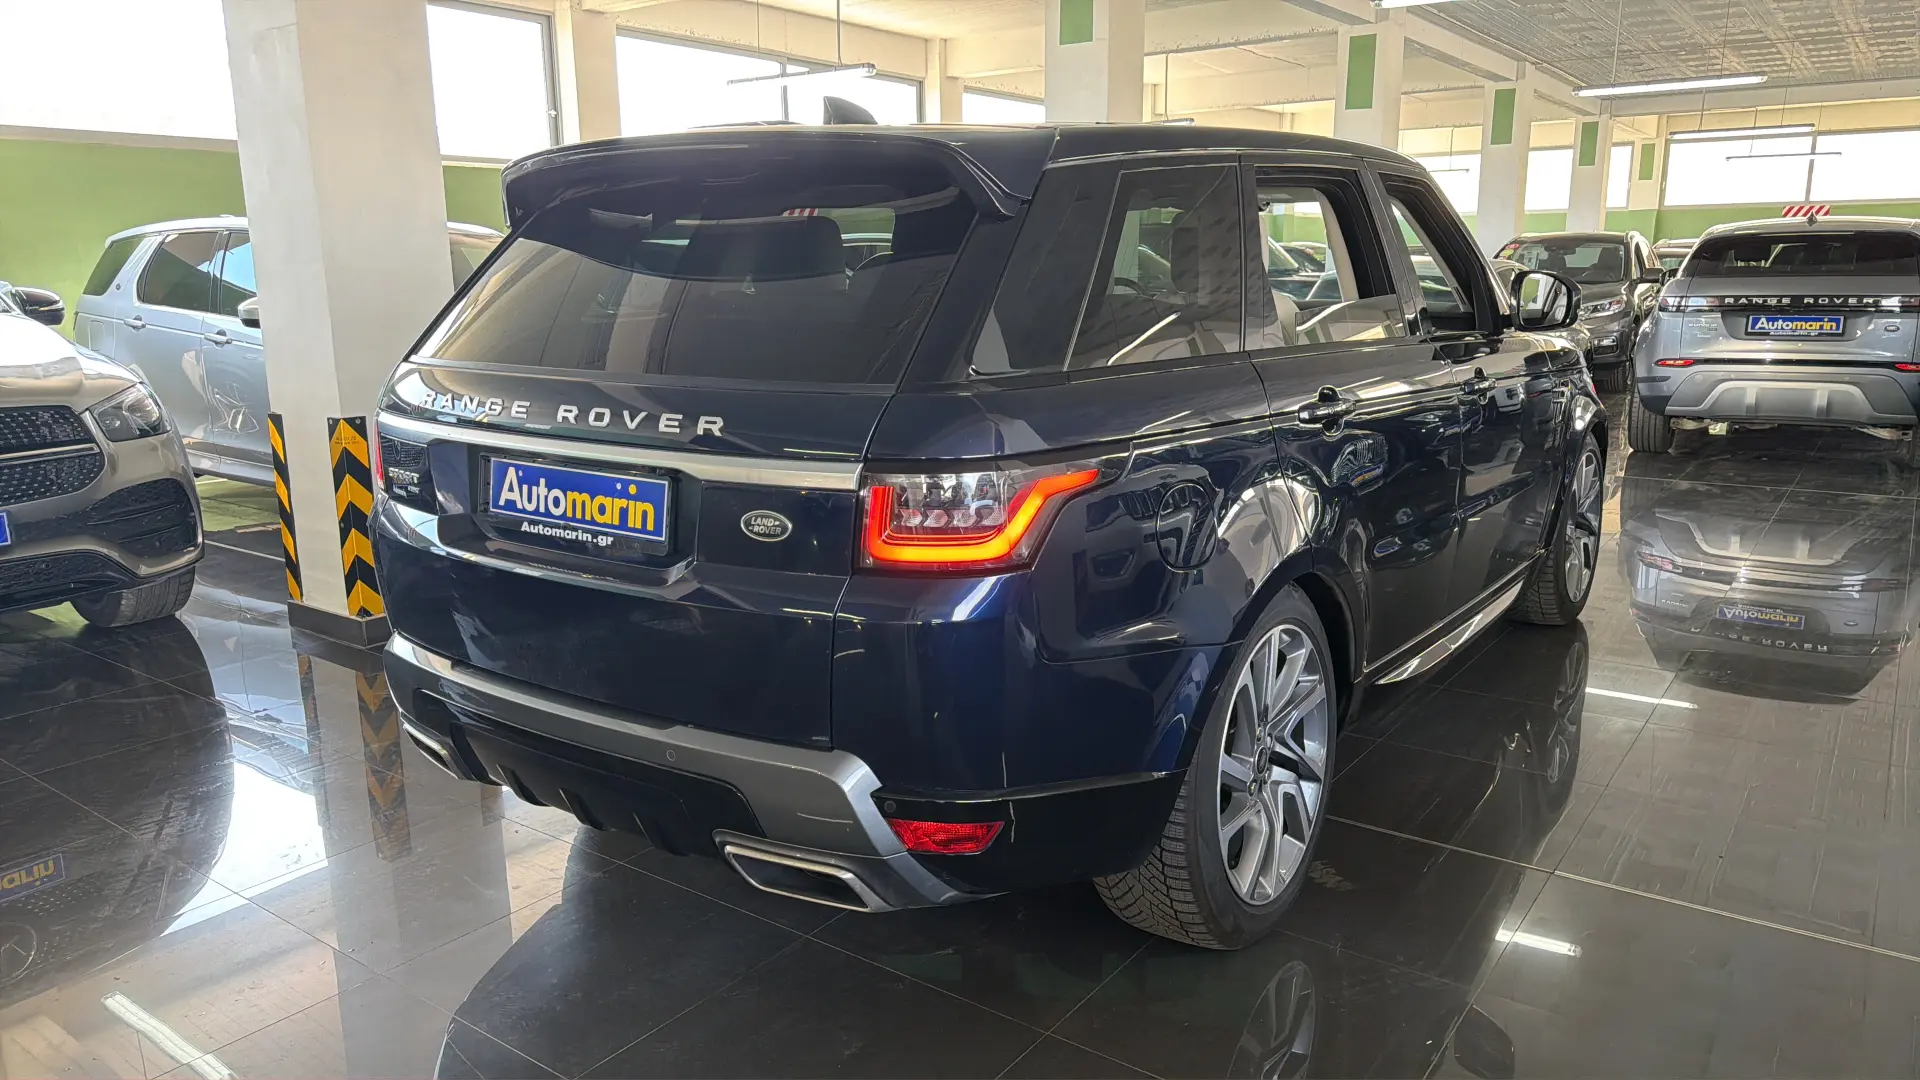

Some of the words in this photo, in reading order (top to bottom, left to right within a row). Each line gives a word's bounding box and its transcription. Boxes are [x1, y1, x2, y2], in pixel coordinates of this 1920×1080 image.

[1754, 317, 1837, 331] Automarin
[421, 391, 531, 420] RANGE
[556, 404, 724, 437] ROVER
[498, 466, 655, 531] Automarin
[750, 516, 775, 527] LAND
[752, 525, 782, 535] ROVER
[520, 521, 614, 547] Automarin.gr
